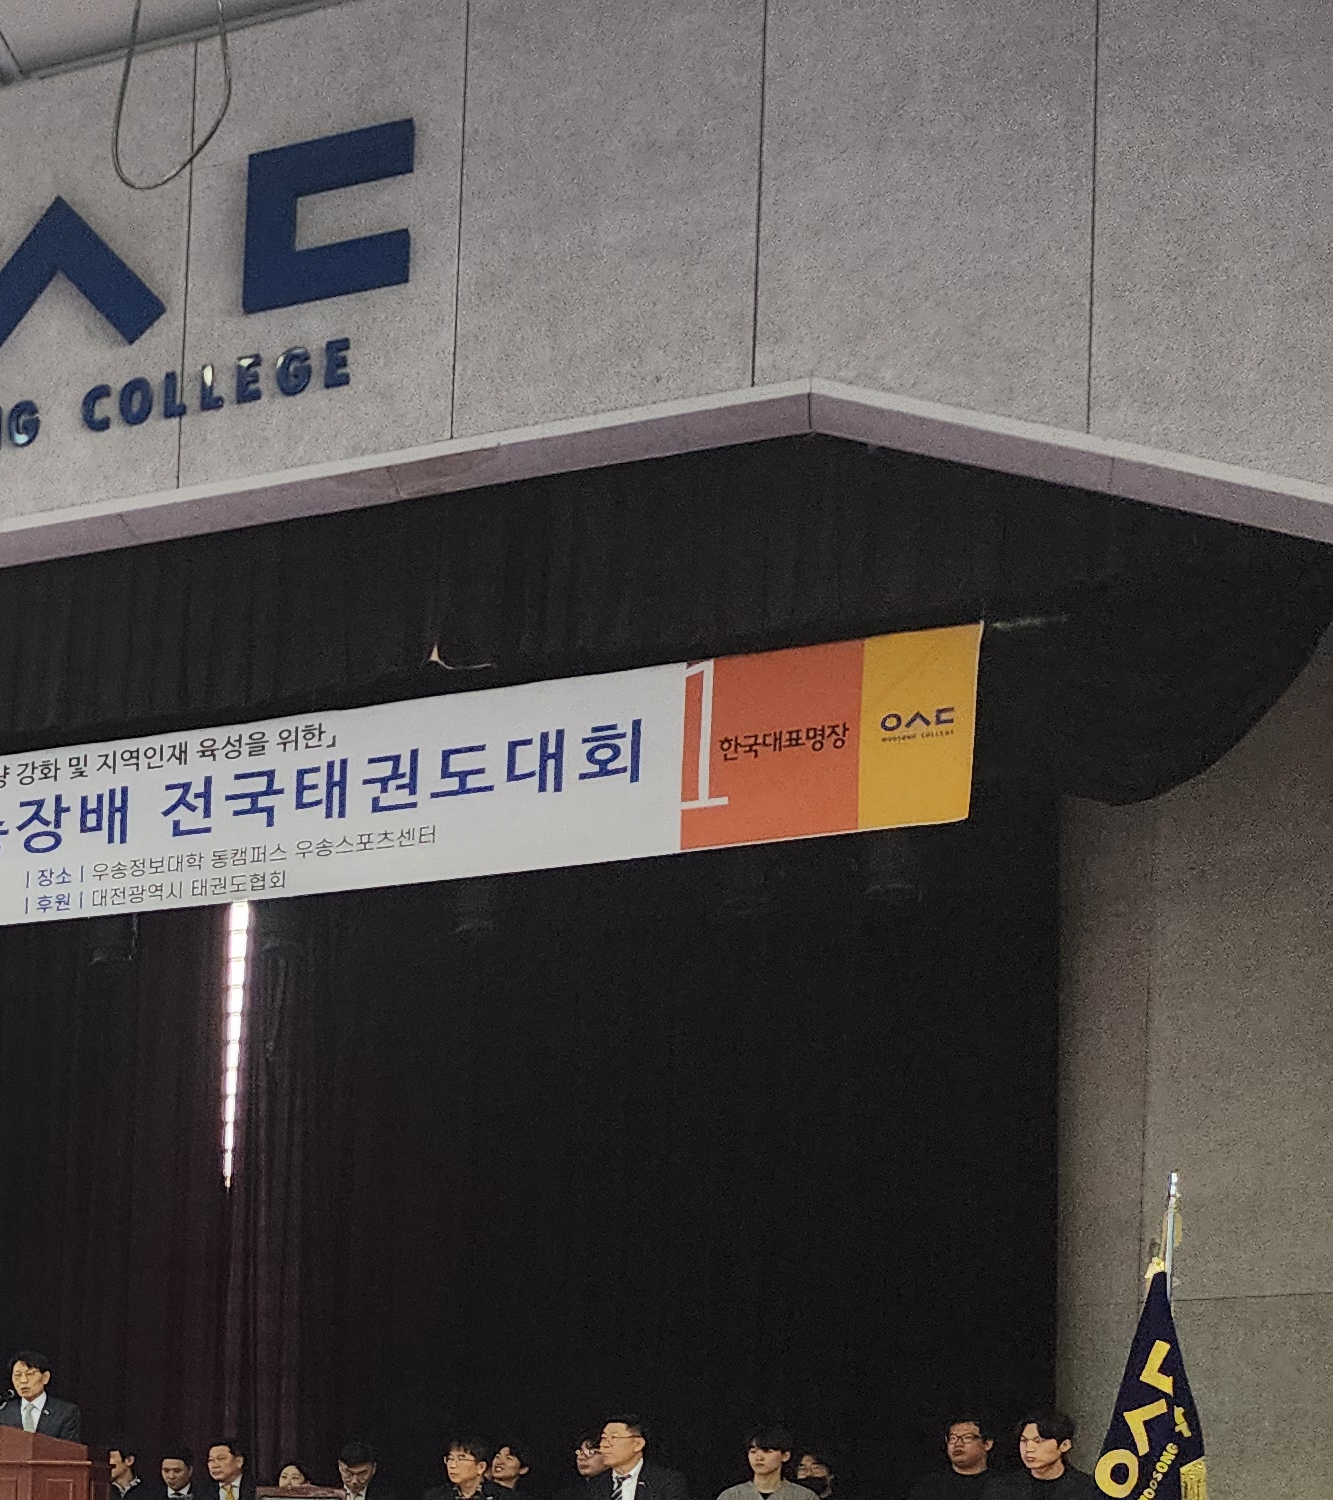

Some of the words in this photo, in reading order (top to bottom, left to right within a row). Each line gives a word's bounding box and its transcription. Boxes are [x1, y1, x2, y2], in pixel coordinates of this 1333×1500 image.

[82, 337, 352, 432] COLLEGE
[16, 759, 60, 786] 강화
[68, 752, 89, 779] 및
[97, 740, 189, 776] 지역인재
[196, 730, 269, 761] 육성을
[718, 722, 851, 762] 한국대표명장
[161, 717, 644, 838] 전국태권도대회
[37, 867, 72, 889] 장소
[92, 851, 205, 881] 우송정보대학
[210, 843, 288, 870] 동캠퍼스
[294, 824, 436, 858] 우송스포츠센터
[36, 892, 72, 914] 후원
[92, 880, 184, 908] 대전광역시
[191, 869, 287, 898] 태권도협회
